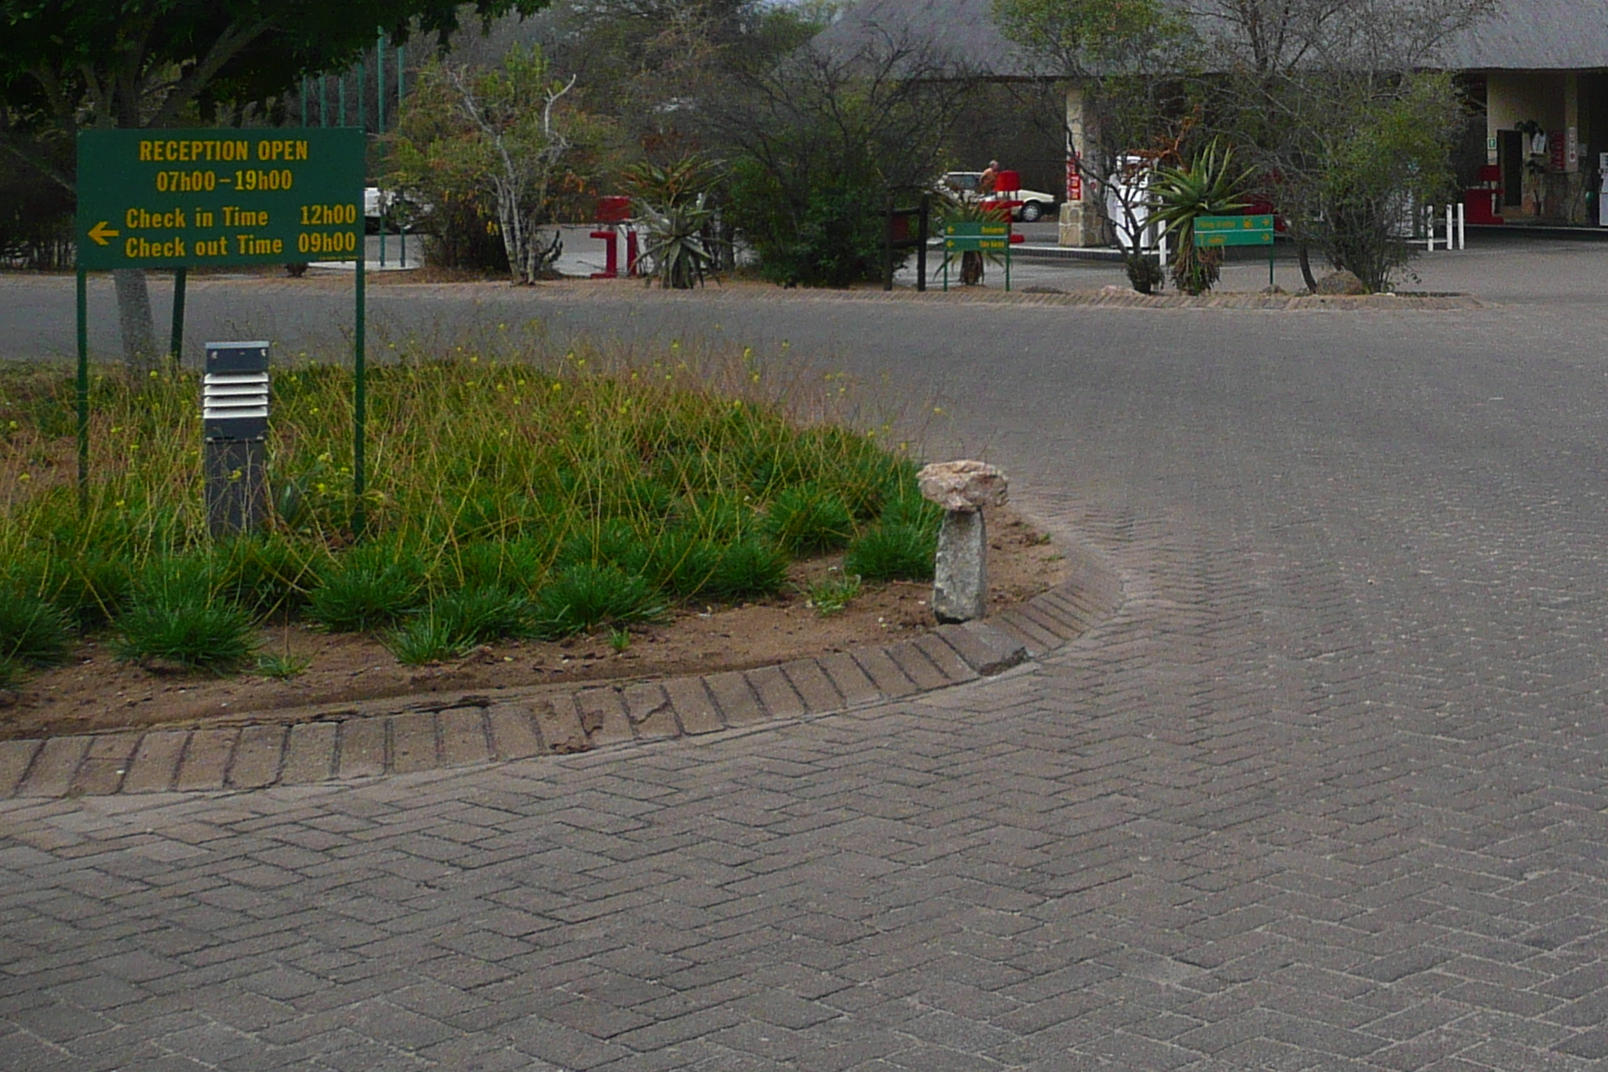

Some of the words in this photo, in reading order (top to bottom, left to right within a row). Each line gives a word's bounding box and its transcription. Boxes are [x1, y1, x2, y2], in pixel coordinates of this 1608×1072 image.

[139, 140, 248, 161] RECEPTION
[257, 140, 308, 161] OPEN
[126, 208, 186, 229] Check
[195, 207, 213, 227] in
[222, 206, 268, 227] Time
[300, 204, 356, 225] 12h00
[125, 237, 186, 258] Check
[195, 236, 228, 256] out
[236, 234, 283, 255] Time
[298, 231, 356, 253] 09h00
